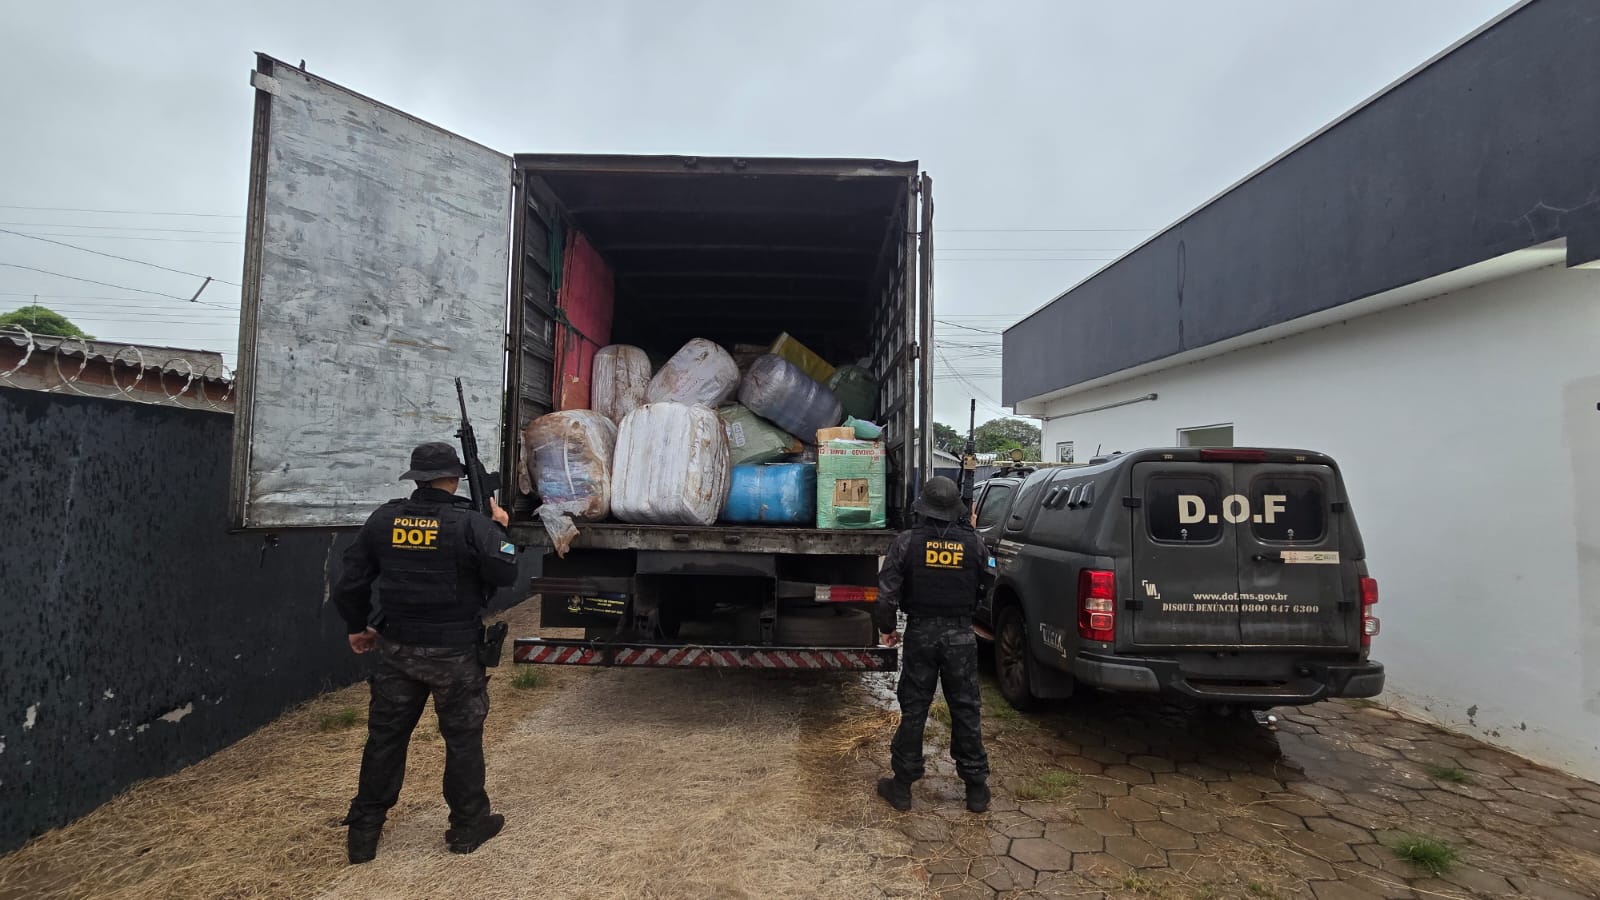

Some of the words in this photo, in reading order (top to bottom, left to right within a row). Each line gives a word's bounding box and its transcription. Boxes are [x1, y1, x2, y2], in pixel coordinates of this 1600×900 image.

[1178, 494, 1286, 524] D.O.F
[394, 518, 438, 528] POLÍCIA
[392, 528, 438, 545] DOF
[926, 541, 964, 550] POLÍCIA
[926, 550, 964, 564] DOF
[1192, 592, 1288, 602] www.dof.ms.gov.br
[1162, 603, 1194, 612] DISQUE
[1242, 604, 1268, 612] 0800
[1271, 604, 1289, 613] 647
[1293, 605, 1319, 613] 6300
